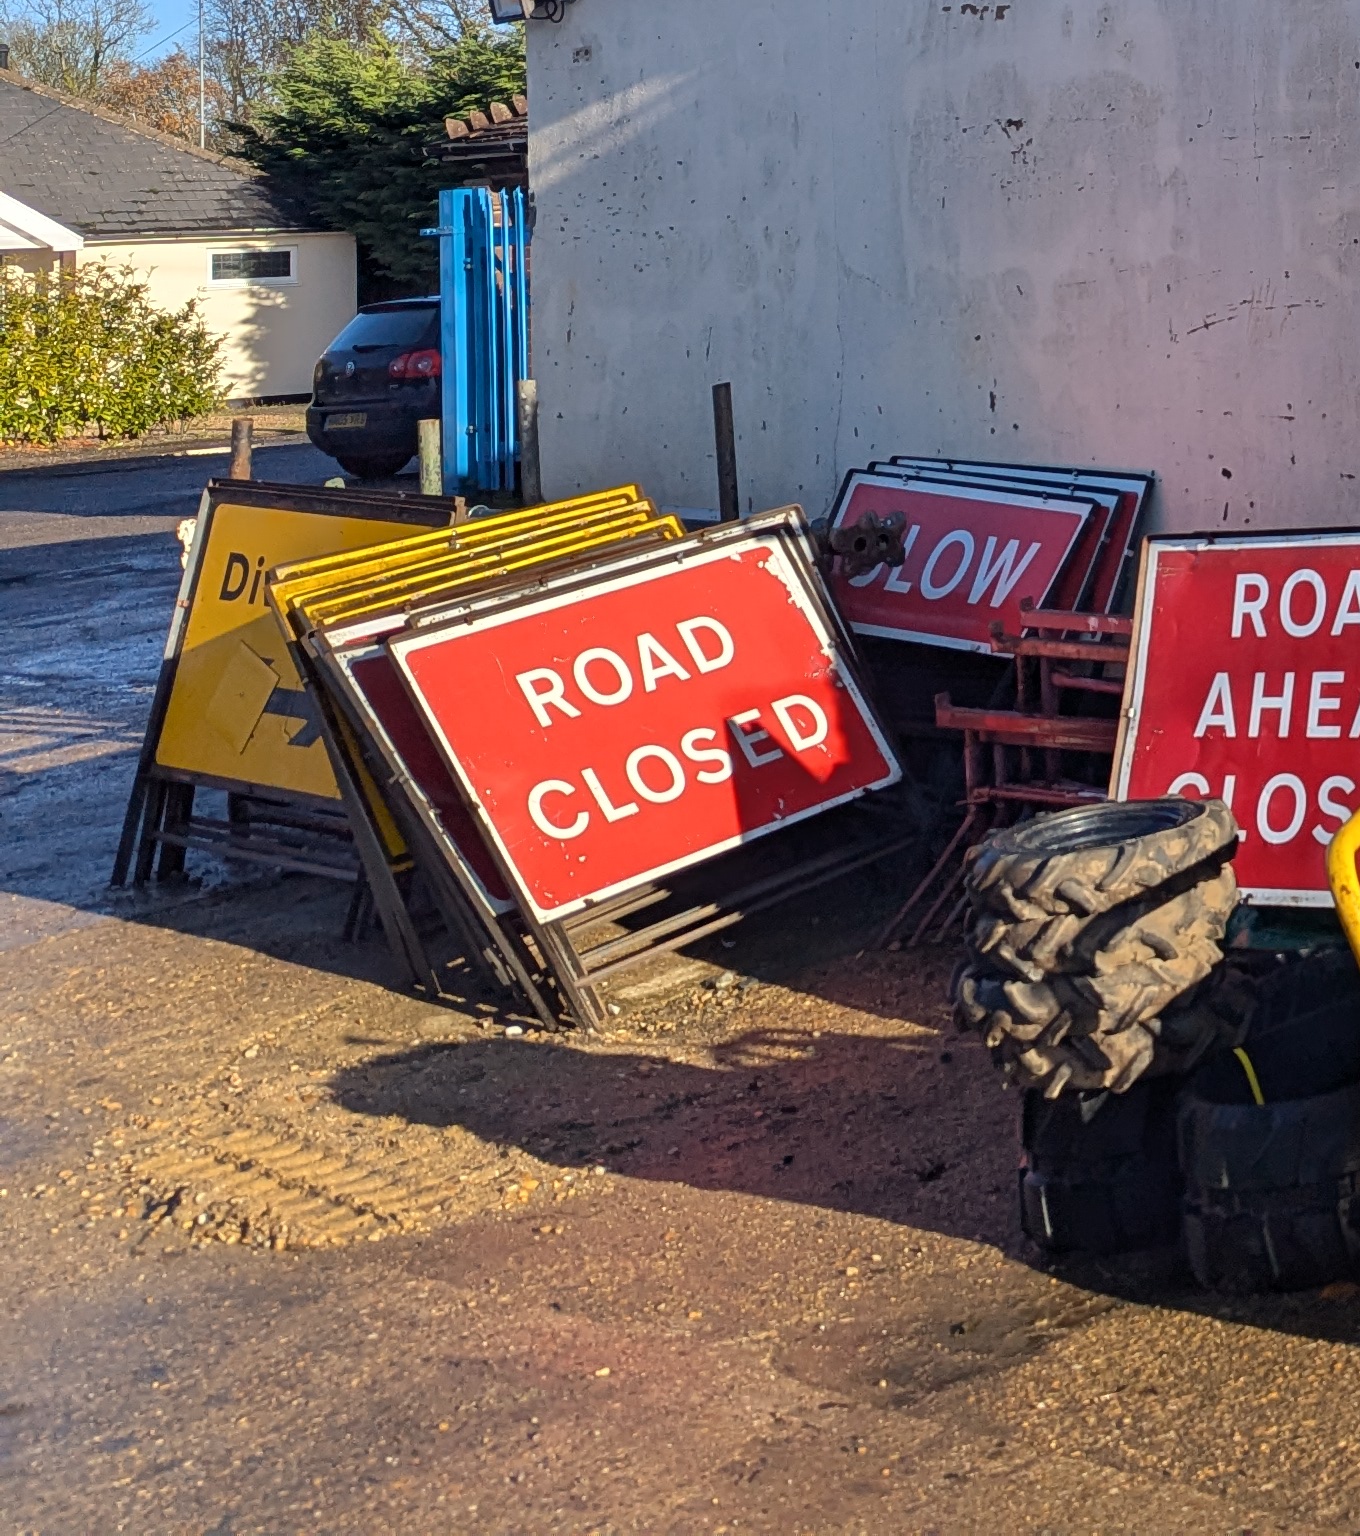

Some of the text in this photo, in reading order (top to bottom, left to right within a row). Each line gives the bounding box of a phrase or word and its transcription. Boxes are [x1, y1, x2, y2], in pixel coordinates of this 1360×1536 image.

[848, 525, 1041, 608] LOW
[515, 616, 734, 728] ROAD
[527, 694, 828, 840] CLOSED
